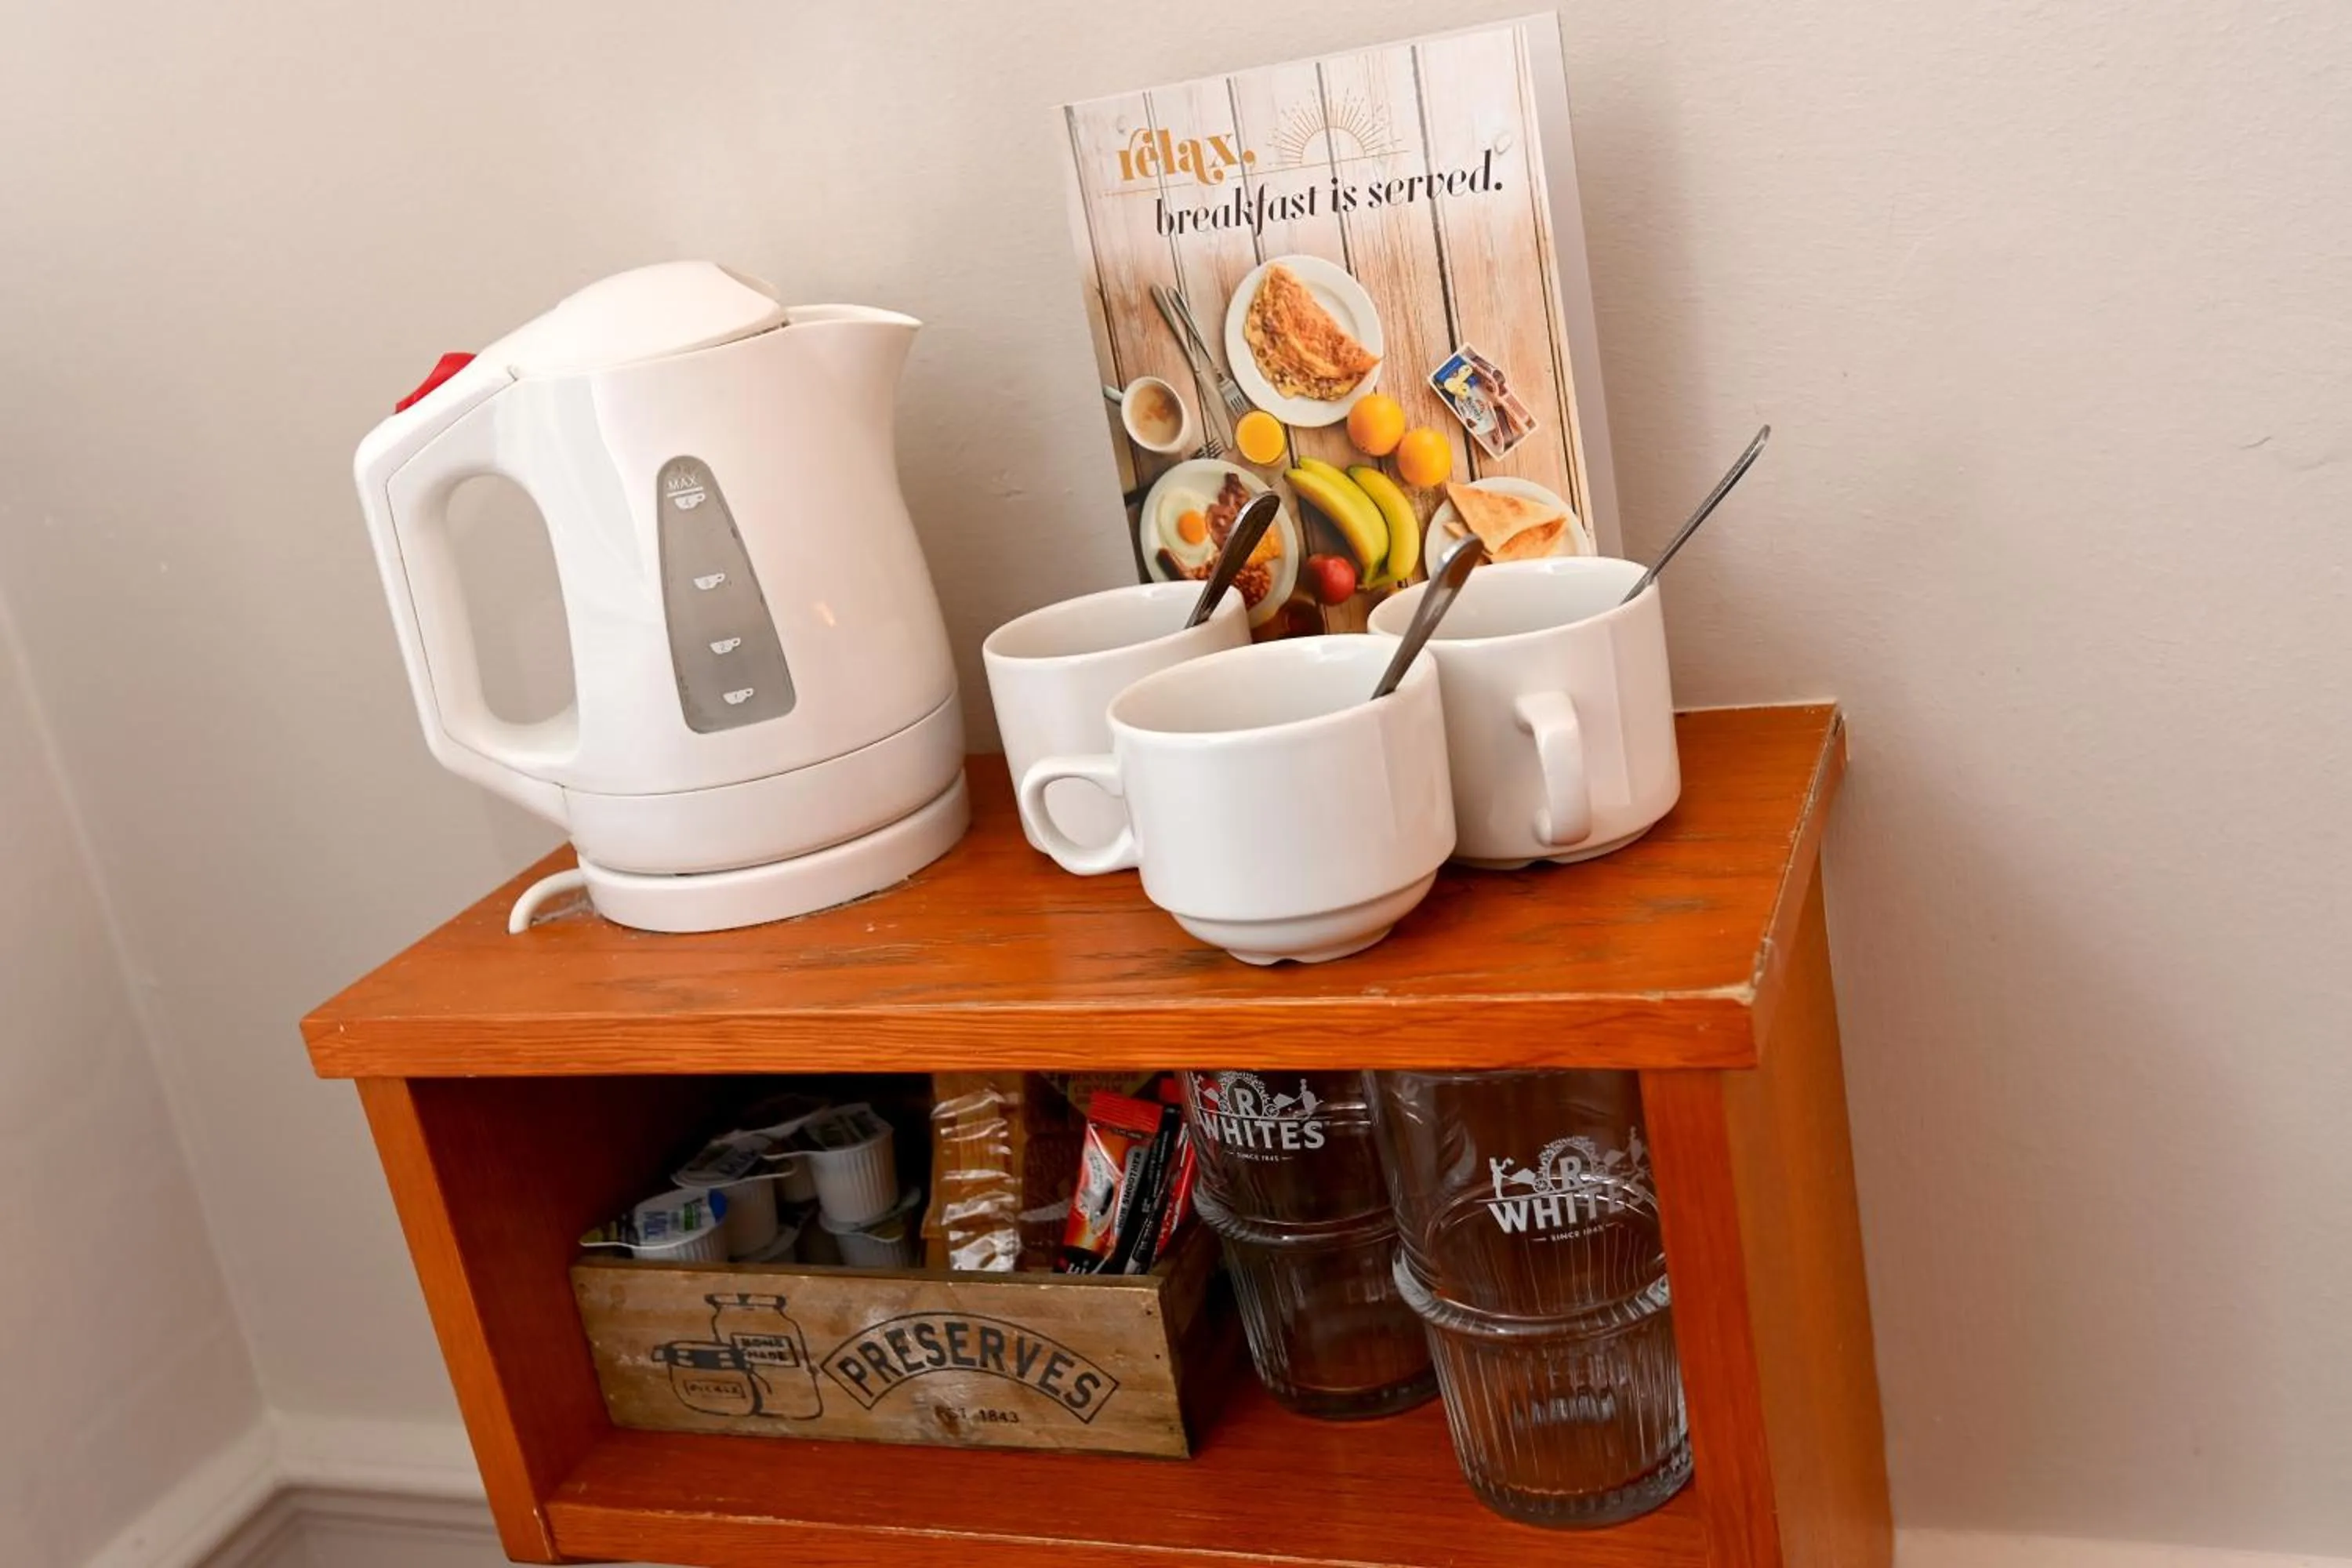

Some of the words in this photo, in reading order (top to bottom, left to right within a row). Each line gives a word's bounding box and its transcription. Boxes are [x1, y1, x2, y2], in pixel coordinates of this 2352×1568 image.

[1116, 128, 1256, 186] relax.
[1155, 183, 1317, 237] breakfast
[1330, 177, 1358, 213] is
[1368, 149, 1503, 209] served.
[668, 475, 697, 490] MAX
[1234, 1087, 1258, 1117] R
[1200, 1110, 1326, 1150] WHITES
[1559, 1156, 1584, 1191] R
[1487, 1176, 1647, 1234] WHITES
[1550, 1230, 1580, 1242] SINCE
[837, 1321, 1102, 1409] PRESERVES
[978, 1409, 1020, 1423] 1843
